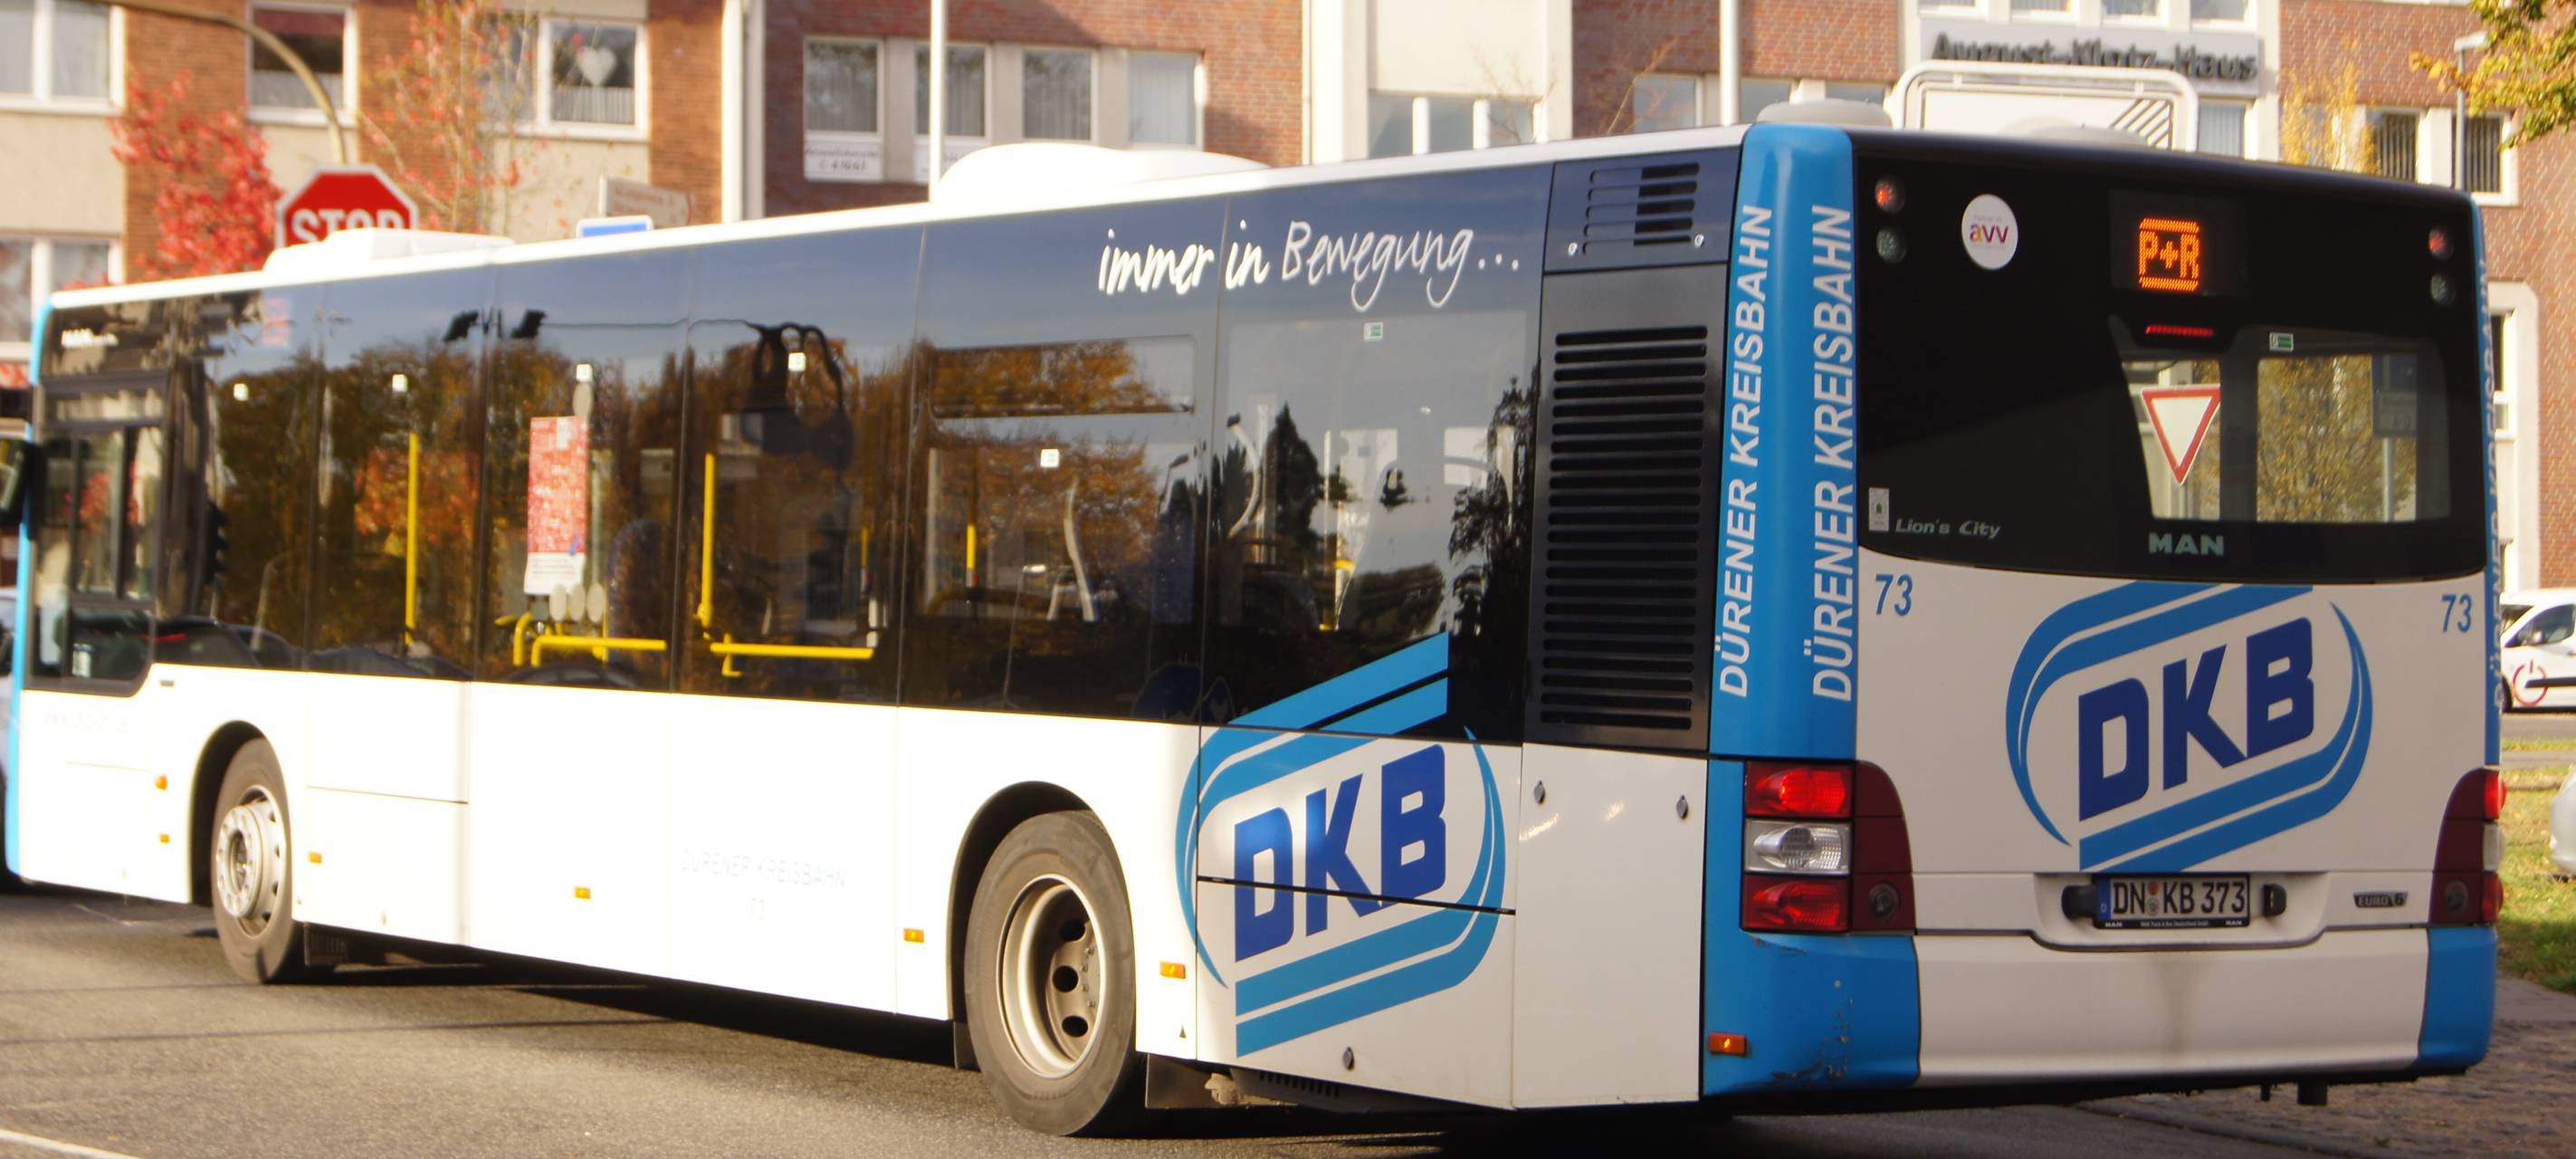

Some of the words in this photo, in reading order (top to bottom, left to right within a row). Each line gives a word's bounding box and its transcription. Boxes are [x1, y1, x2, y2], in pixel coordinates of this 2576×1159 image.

[1099, 228, 1214, 295] immer
[1225, 219, 1270, 289] in
[2139, 229, 2199, 279] P+R
[1729, 205, 1772, 468] KREISBAHN
[1811, 205, 1854, 470] KREISBAHN
[1895, 518, 1951, 534] Lion's
[1959, 520, 2001, 540] City
[2148, 532, 2224, 556] MAN
[1713, 478, 1758, 698] DÜRENER
[1803, 480, 1854, 702] DÜRENER
[1875, 573, 1913, 617] 73
[2440, 594, 2473, 633] 73
[2078, 617, 2314, 823] DKB
[1234, 743, 1446, 963] DKB
[2113, 881, 2145, 915] DN
[2163, 882, 2195, 915] KB
[2201, 882, 2245, 914] 373
